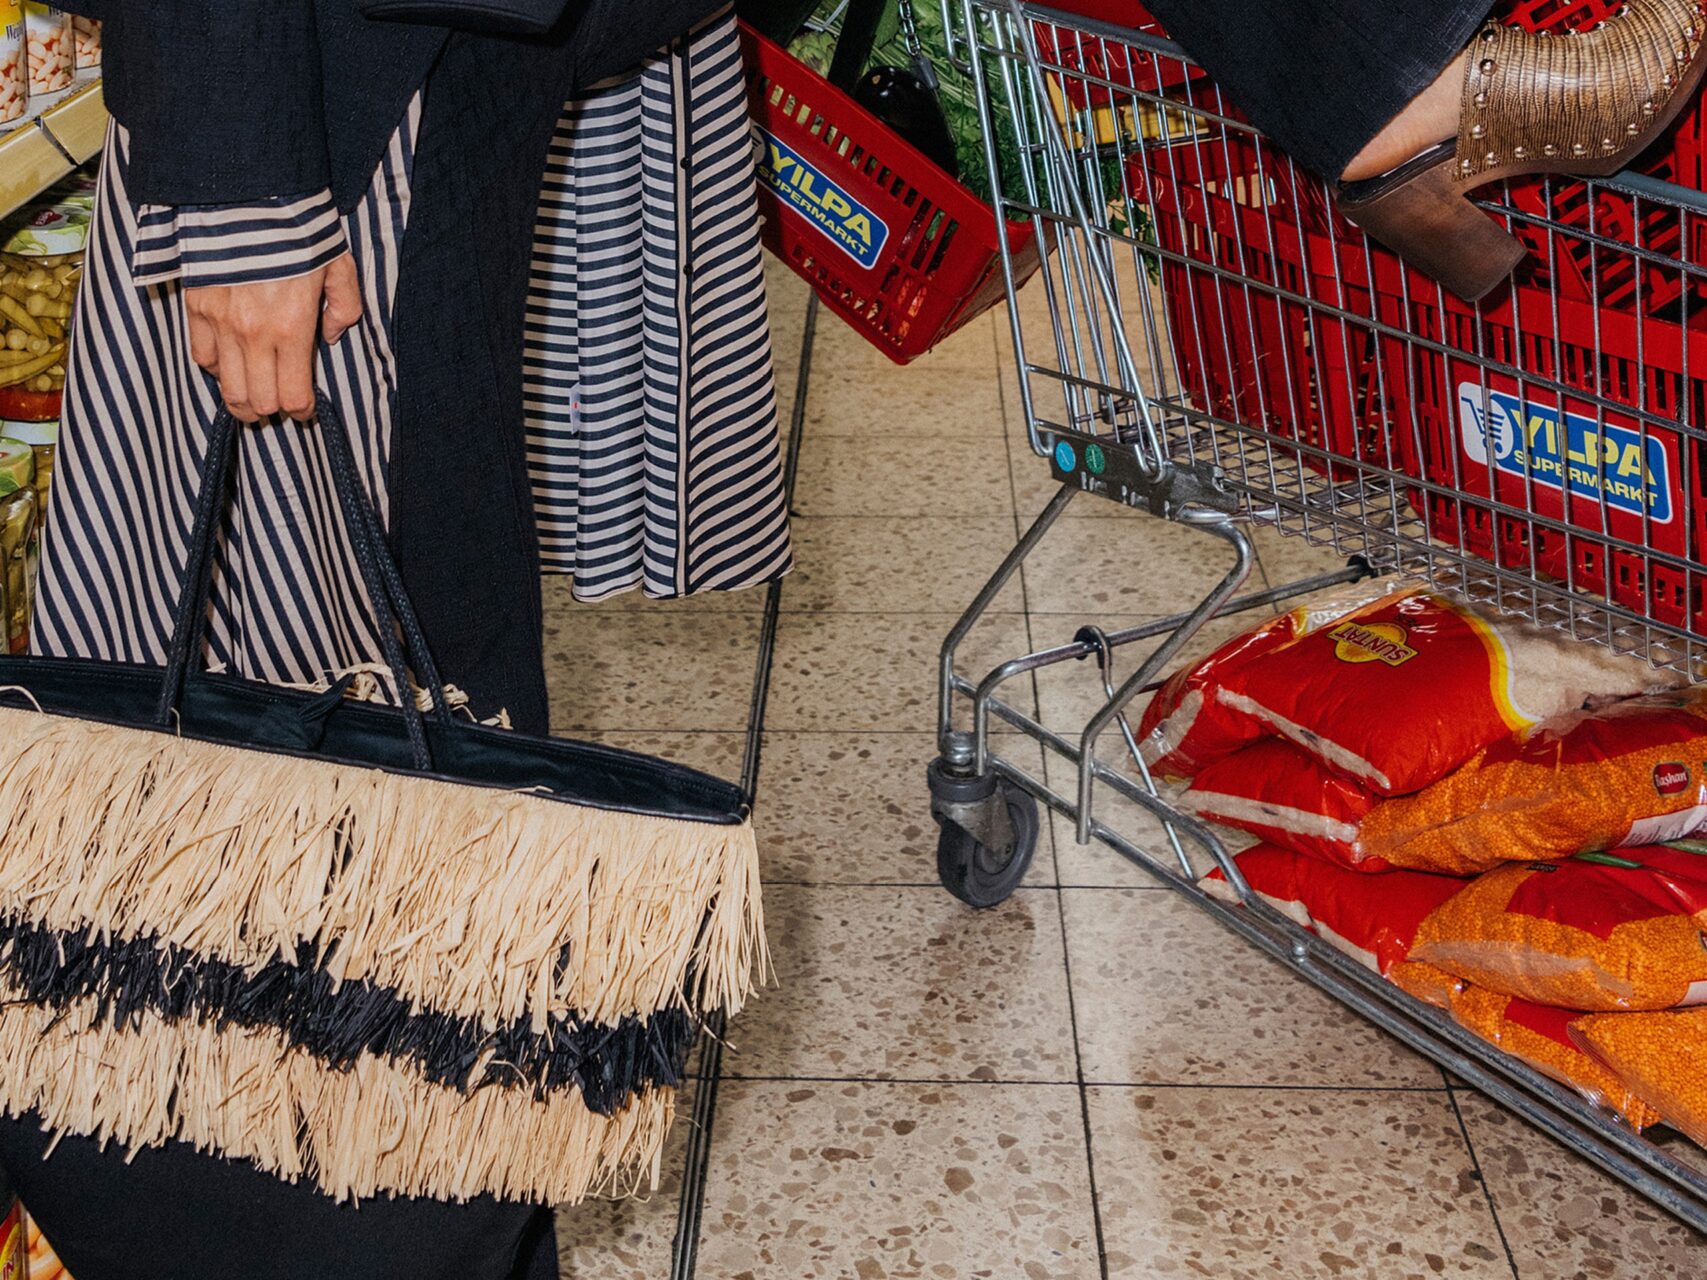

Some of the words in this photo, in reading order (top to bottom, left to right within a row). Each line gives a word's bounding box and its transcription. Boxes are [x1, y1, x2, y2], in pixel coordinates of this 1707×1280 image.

[759, 165, 869, 256] SUPERMARKT
[770, 143, 872, 246] YILPA
[1510, 408, 1657, 486] YILPA
[1513, 449, 1658, 507] SUPERMARKT
[1334, 625, 1411, 661] SUNTAT
